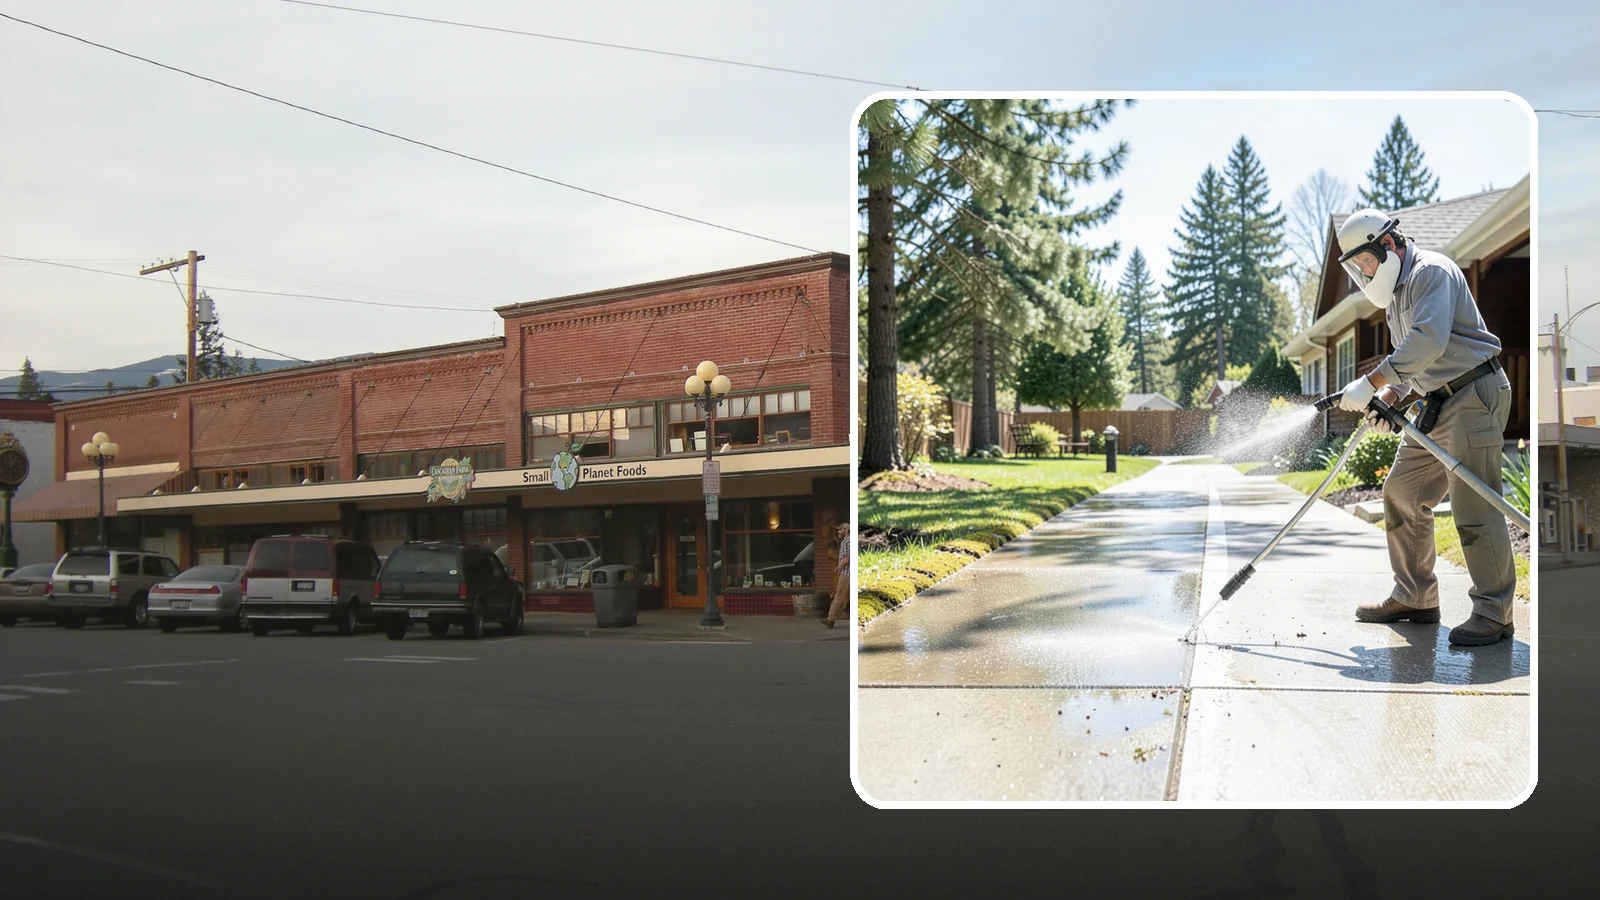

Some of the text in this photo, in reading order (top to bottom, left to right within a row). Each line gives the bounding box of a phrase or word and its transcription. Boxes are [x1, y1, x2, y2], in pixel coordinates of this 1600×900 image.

[431, 466, 469, 476] CASCADIAN FARM
[523, 465, 647, 483] Small Planet Foods
